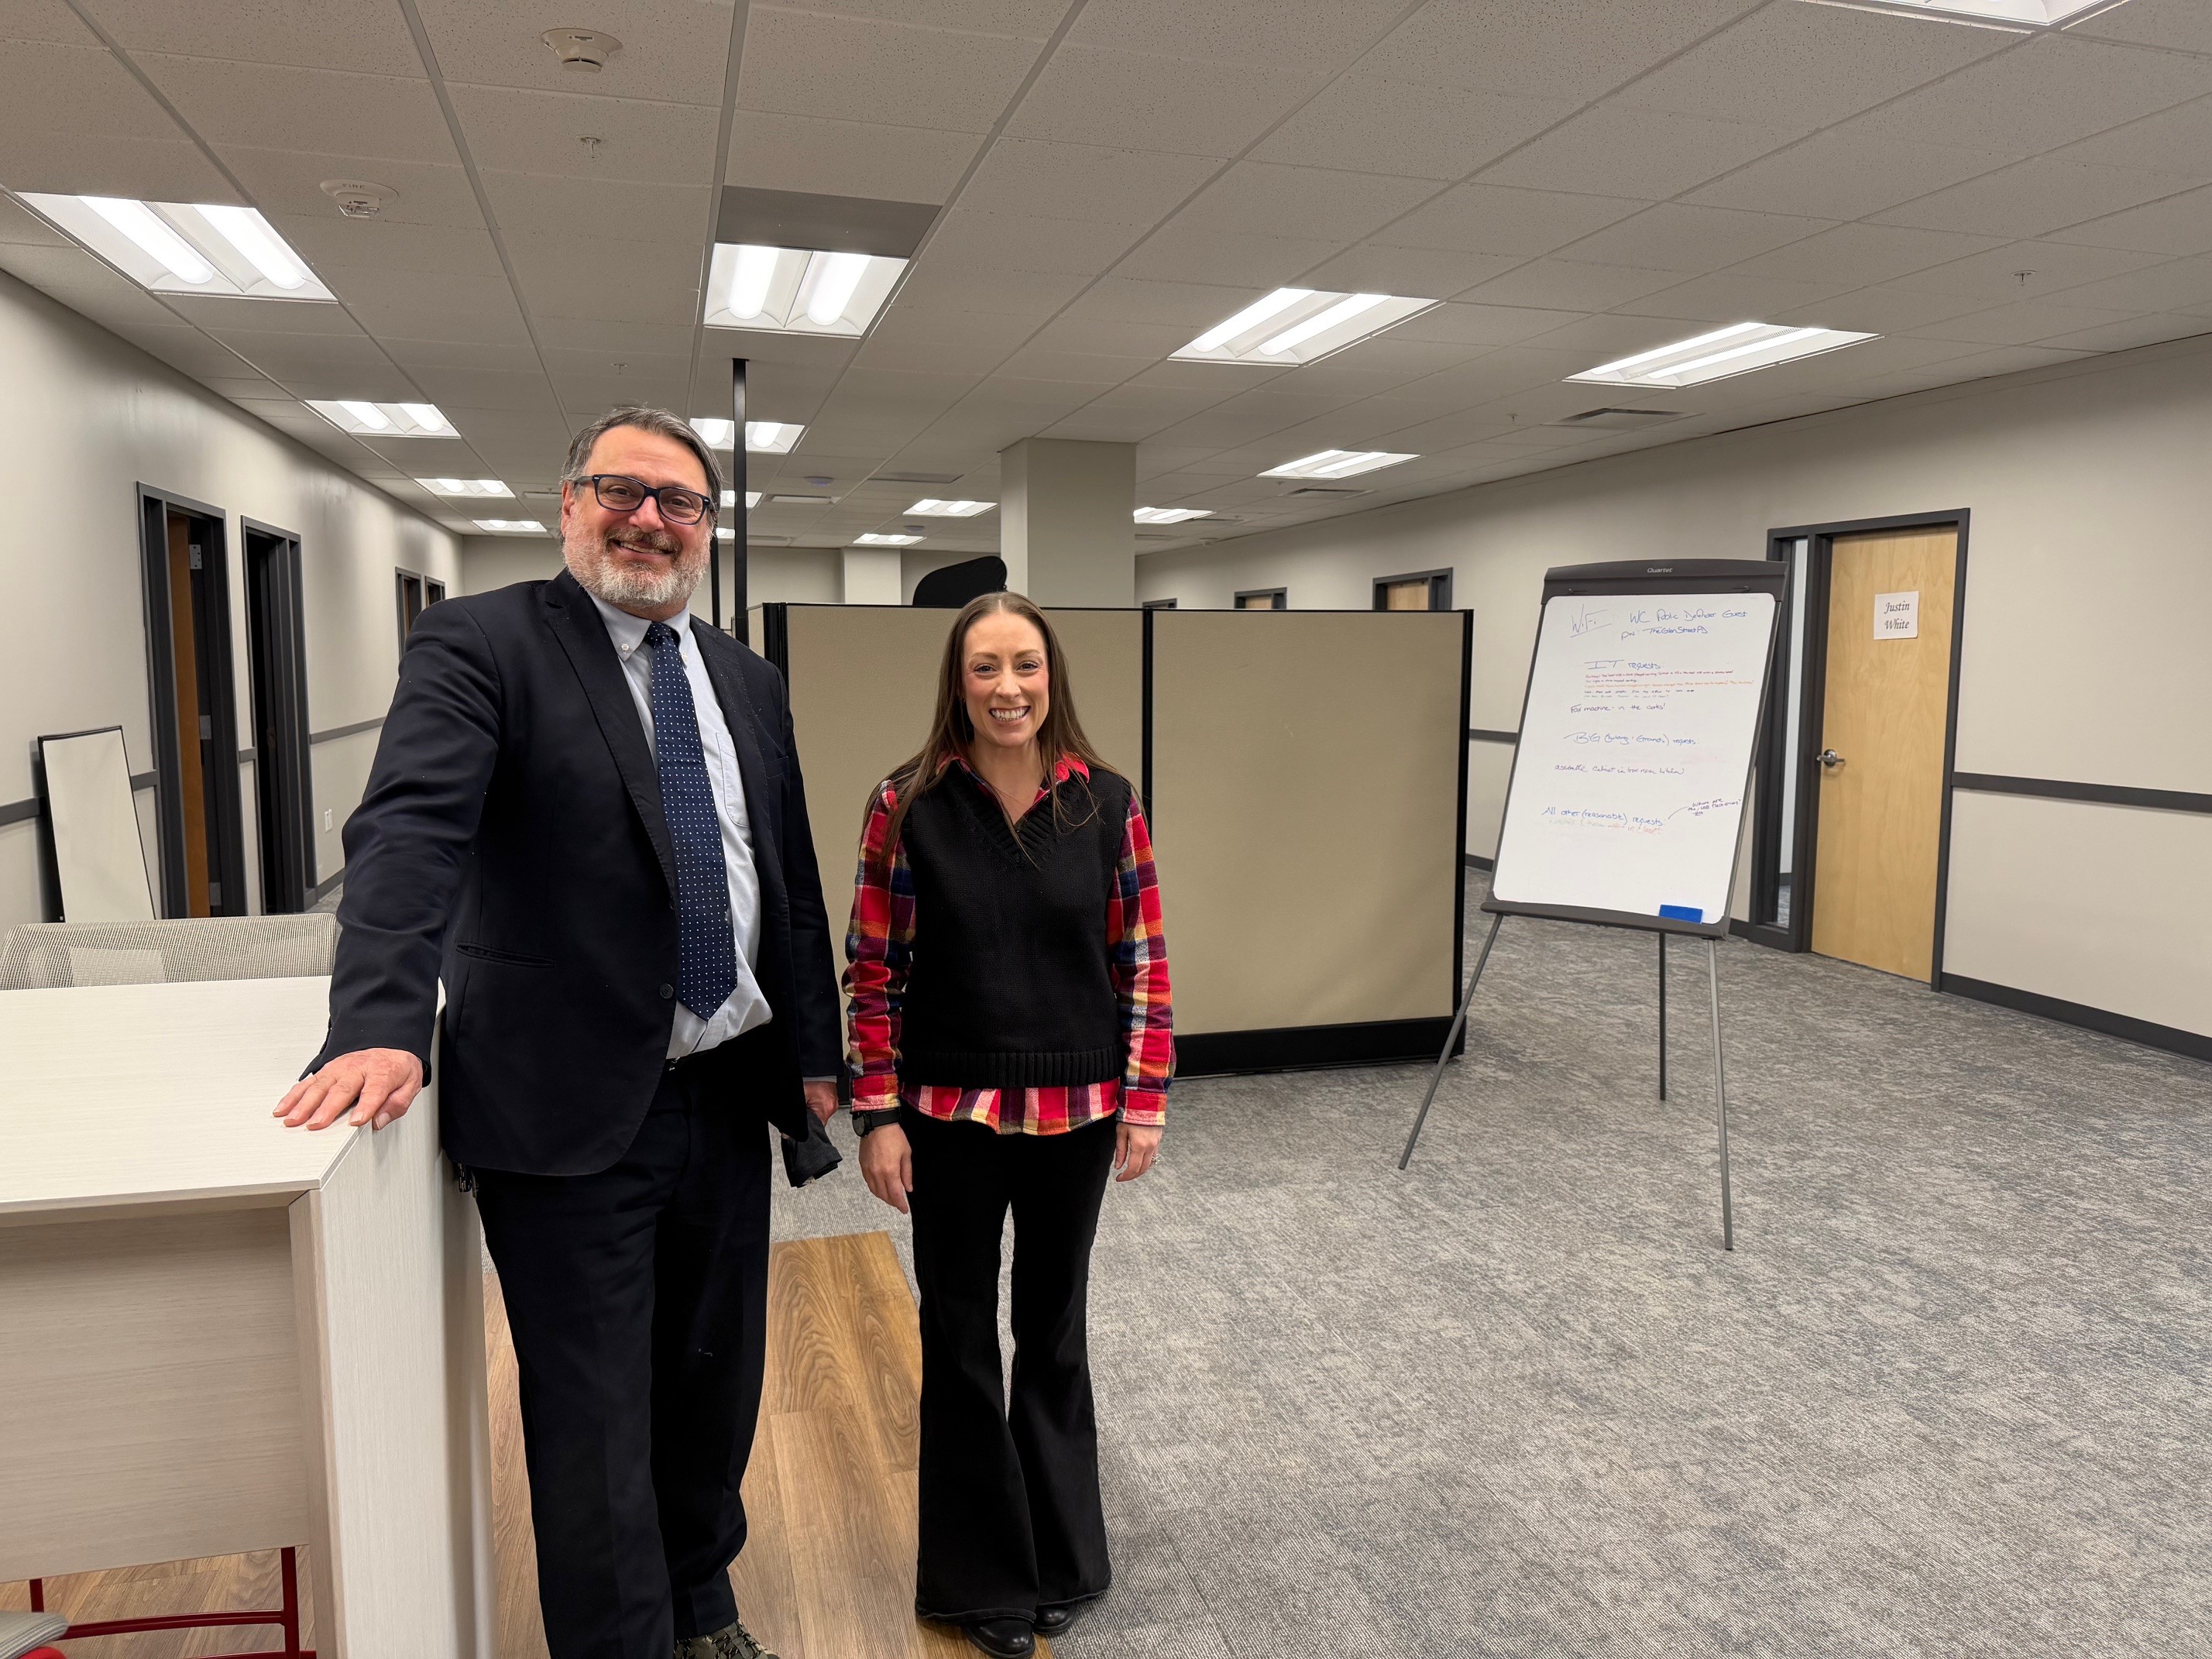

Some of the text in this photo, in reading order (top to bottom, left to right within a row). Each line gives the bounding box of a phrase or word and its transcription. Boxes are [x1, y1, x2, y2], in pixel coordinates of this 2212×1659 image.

[1884, 600, 1910, 614] Justin
[1630, 610, 1650, 623] WC
[1723, 610, 1747, 619] Guest
[1884, 618, 1910, 630] White
[1585, 660, 1625, 670] IT
